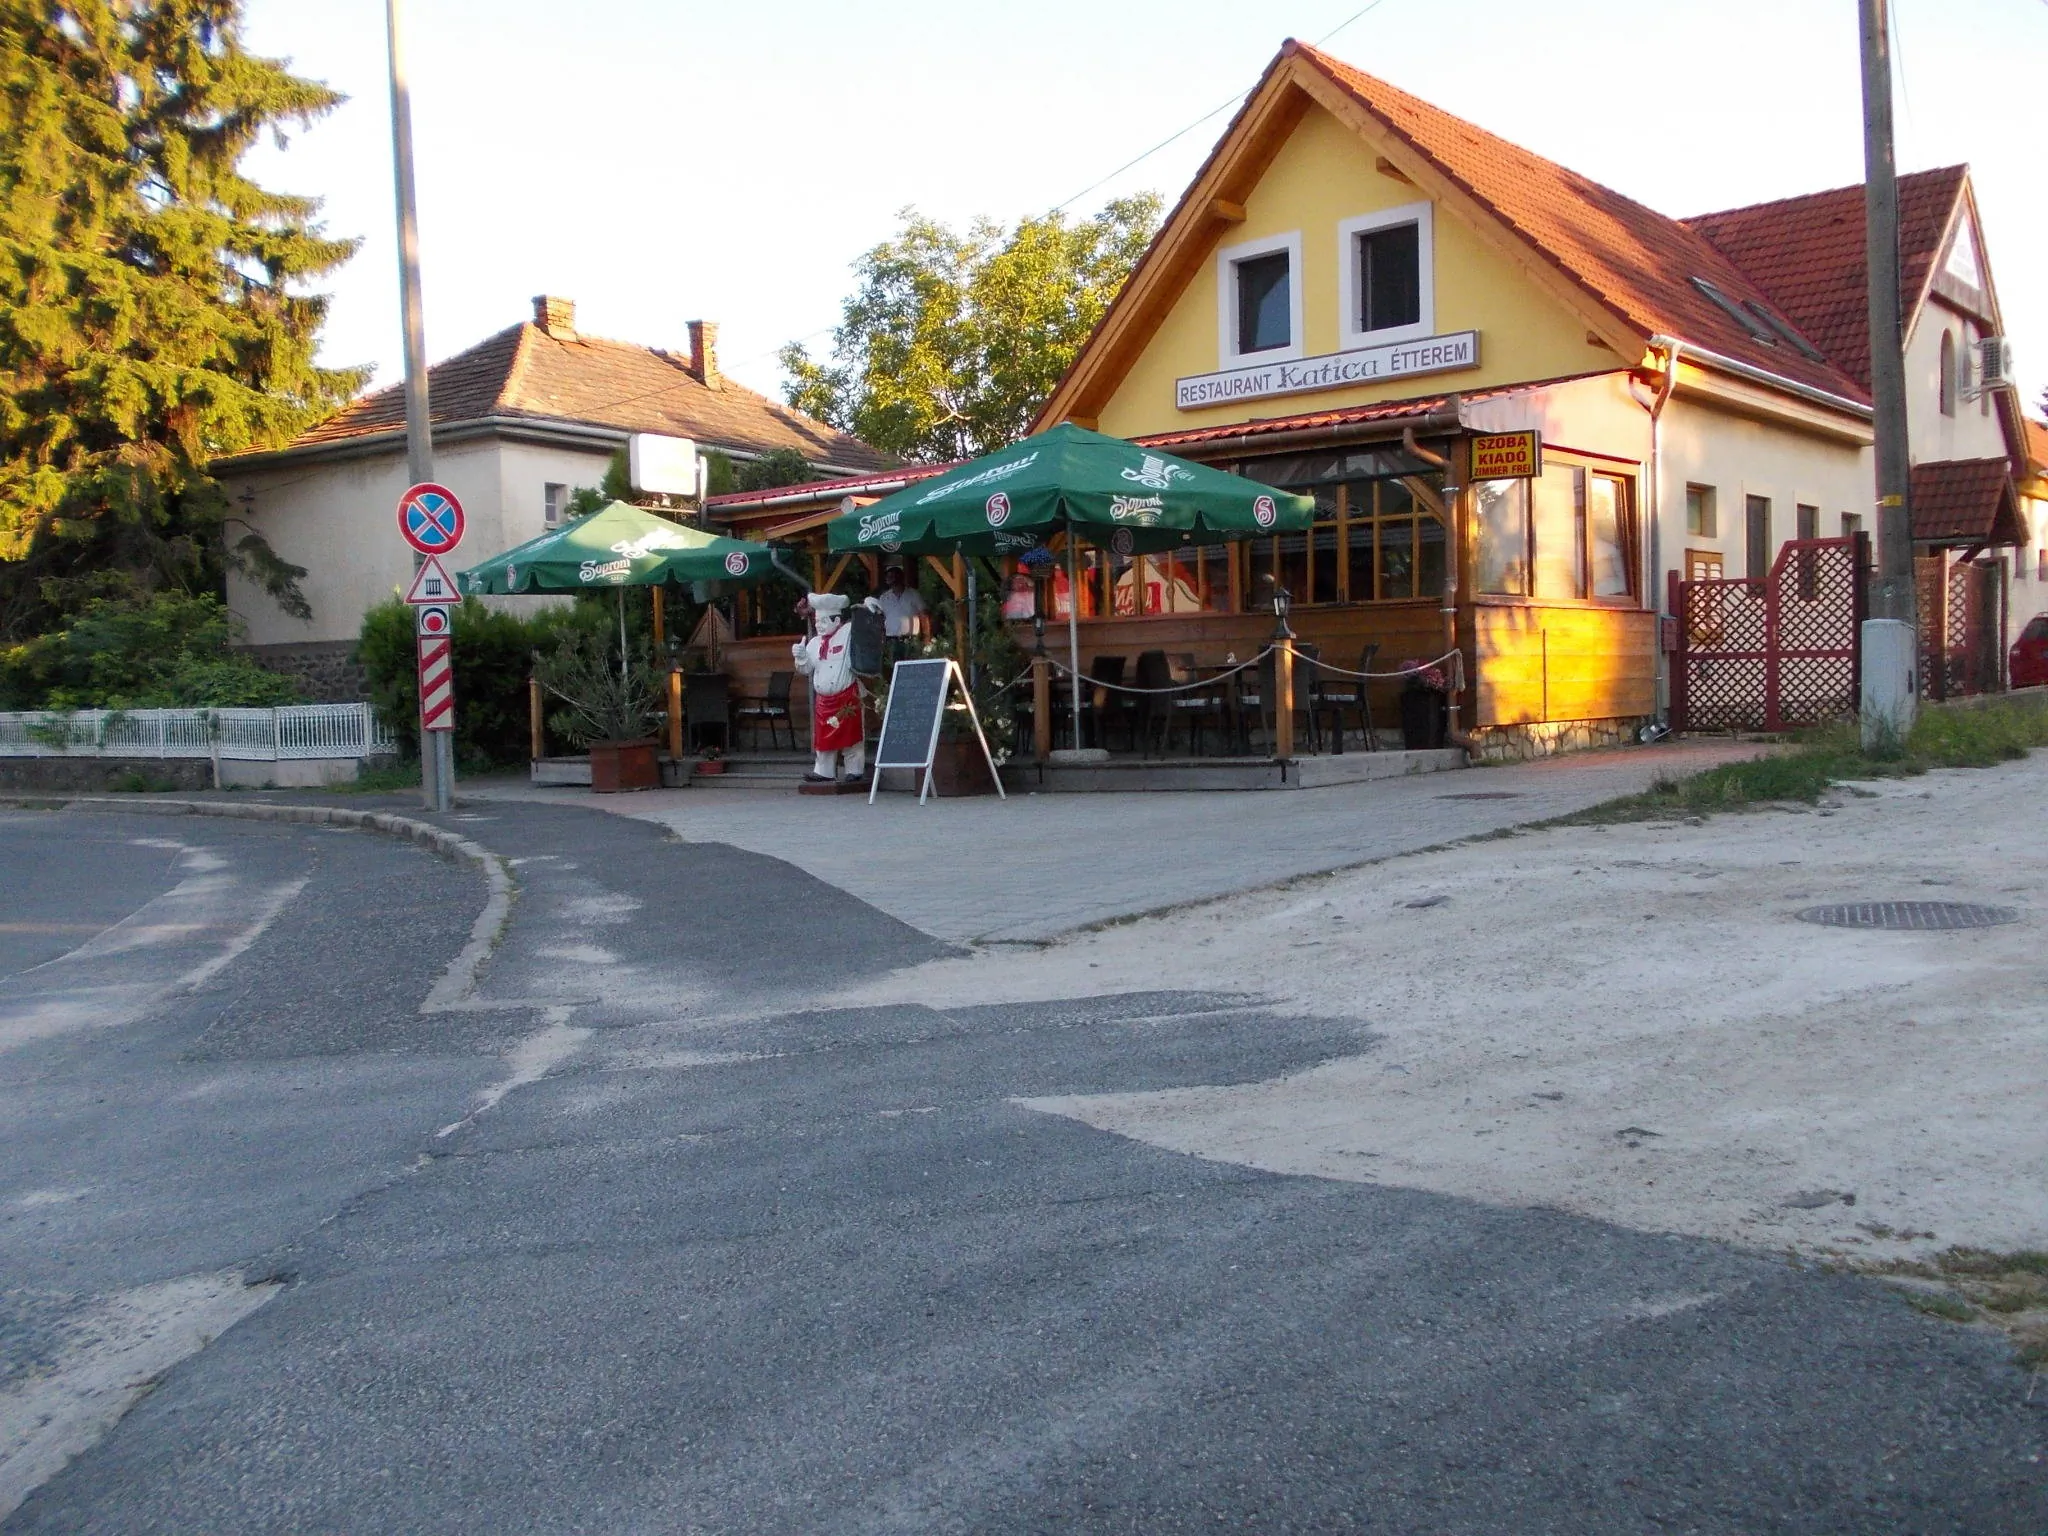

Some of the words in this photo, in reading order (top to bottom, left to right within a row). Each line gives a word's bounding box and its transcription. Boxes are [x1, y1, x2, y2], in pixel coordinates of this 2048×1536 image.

[1180, 373, 1271, 403] RESTAURANT
[1277, 357, 1379, 388] Katica
[1391, 343, 1468, 371] ÉTTEREM
[1477, 435, 1527, 450] SZOBA
[1478, 447, 1526, 465] KIADÓ
[1475, 465, 1508, 476] ZIMMER
[1512, 463, 1530, 473] FREI
[1110, 492, 1164, 521] Soproni
[579, 559, 631, 583] Soproni
